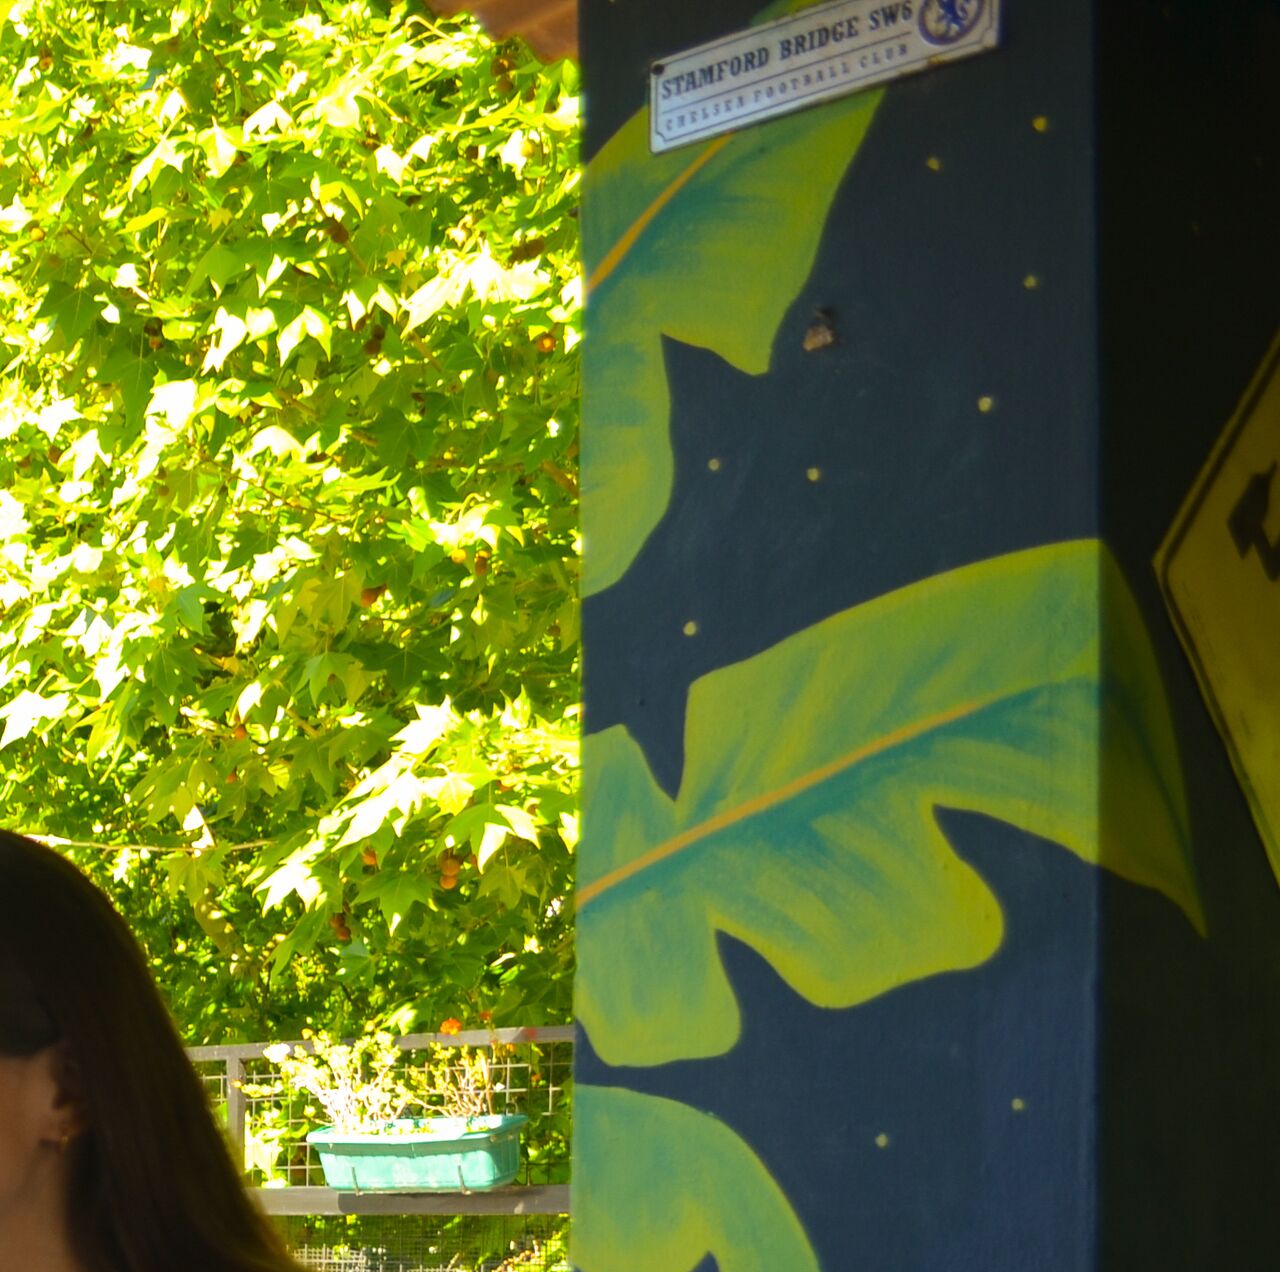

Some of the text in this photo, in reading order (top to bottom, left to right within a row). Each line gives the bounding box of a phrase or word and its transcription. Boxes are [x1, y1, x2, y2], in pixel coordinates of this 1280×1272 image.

[661, 1, 913, 100] STAMFORD BRIDGE SW6
[666, 43, 907, 131] CHELSEA FOOTBALL CLUB
